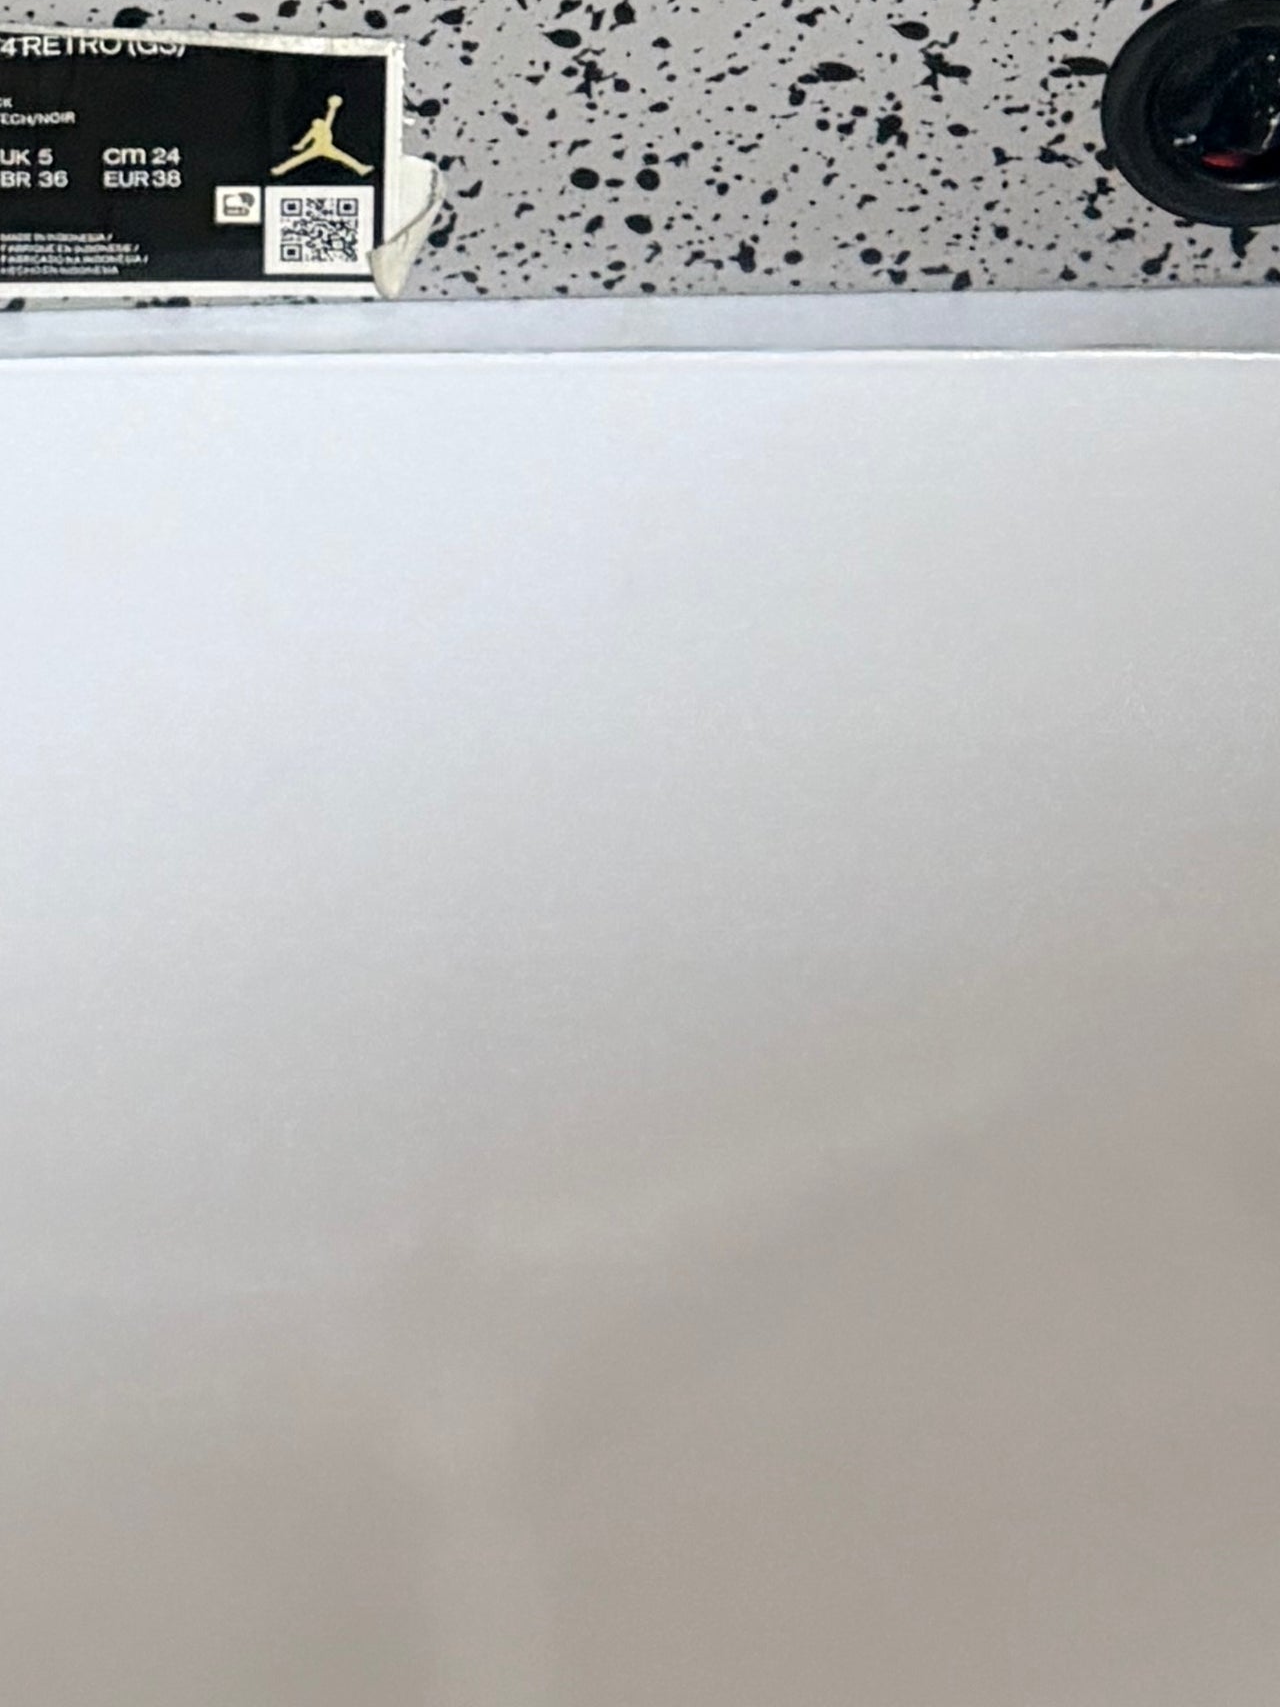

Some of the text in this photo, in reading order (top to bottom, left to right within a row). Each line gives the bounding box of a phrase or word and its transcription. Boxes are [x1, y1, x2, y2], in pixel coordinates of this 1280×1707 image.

[0, 37, 18, 57] 4
[0, 148, 32, 166] UK
[37, 148, 54, 166] 5
[152, 147, 181, 165] 24
[0, 169, 182, 188] BR 36 EUR 38
